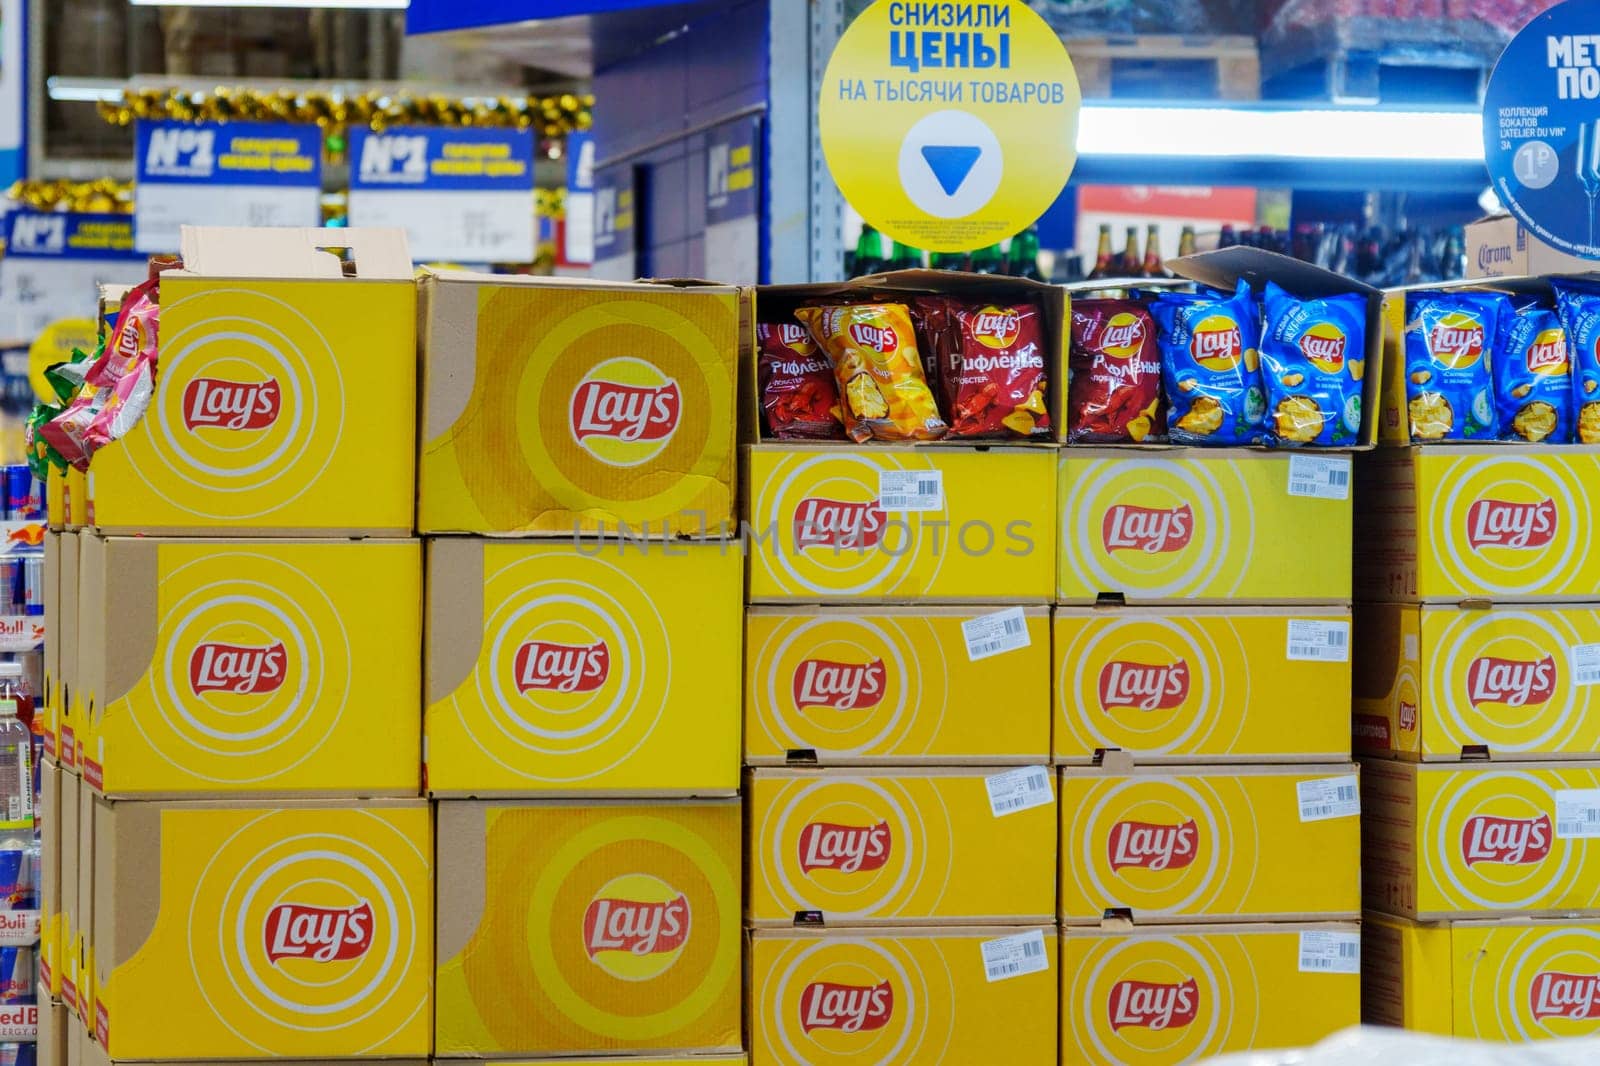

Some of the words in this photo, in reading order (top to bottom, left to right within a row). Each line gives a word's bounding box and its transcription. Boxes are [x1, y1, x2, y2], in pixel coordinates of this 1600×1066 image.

[889, 2, 1011, 27] СНИЗИЛИ
[889, 30, 1011, 73] ЦЕНЫ
[839, 79, 867, 101] НА
[873, 79, 962, 102] ТЫСЯЧИ
[969, 81, 1064, 104] ТОВАРОВ
[1499, 106, 1548, 117] КОЛЛЕКЦИЯ
[1500, 118, 1538, 128] БОКАЛОВ
[1501, 140, 1512, 151] ЗА
[853, 323, 894, 353] Lay's
[976, 312, 1018, 339] Lay's
[1195, 325, 1241, 359] Lay's
[1302, 334, 1344, 364] Lay's
[1434, 325, 1483, 357] Lay's
[192, 378, 276, 430] Lay's
[579, 379, 673, 442] Lay's
[799, 498, 882, 551] Lay's
[1106, 503, 1189, 554] Lay's
[1471, 499, 1553, 550] Lay's
[197, 642, 284, 695] Lay's
[521, 642, 605, 694] Lay's
[800, 657, 883, 711] Lay's
[1103, 659, 1186, 711] Lay's
[1471, 656, 1553, 707] Lay's
[804, 821, 888, 873] Lay's
[1112, 820, 1194, 871] Lay's
[1466, 815, 1547, 866] Lay's
[269, 904, 369, 962] Lay's
[589, 897, 685, 956] Lay's
[805, 981, 888, 1033] Lay's
[1113, 978, 1194, 1030] Lay's
